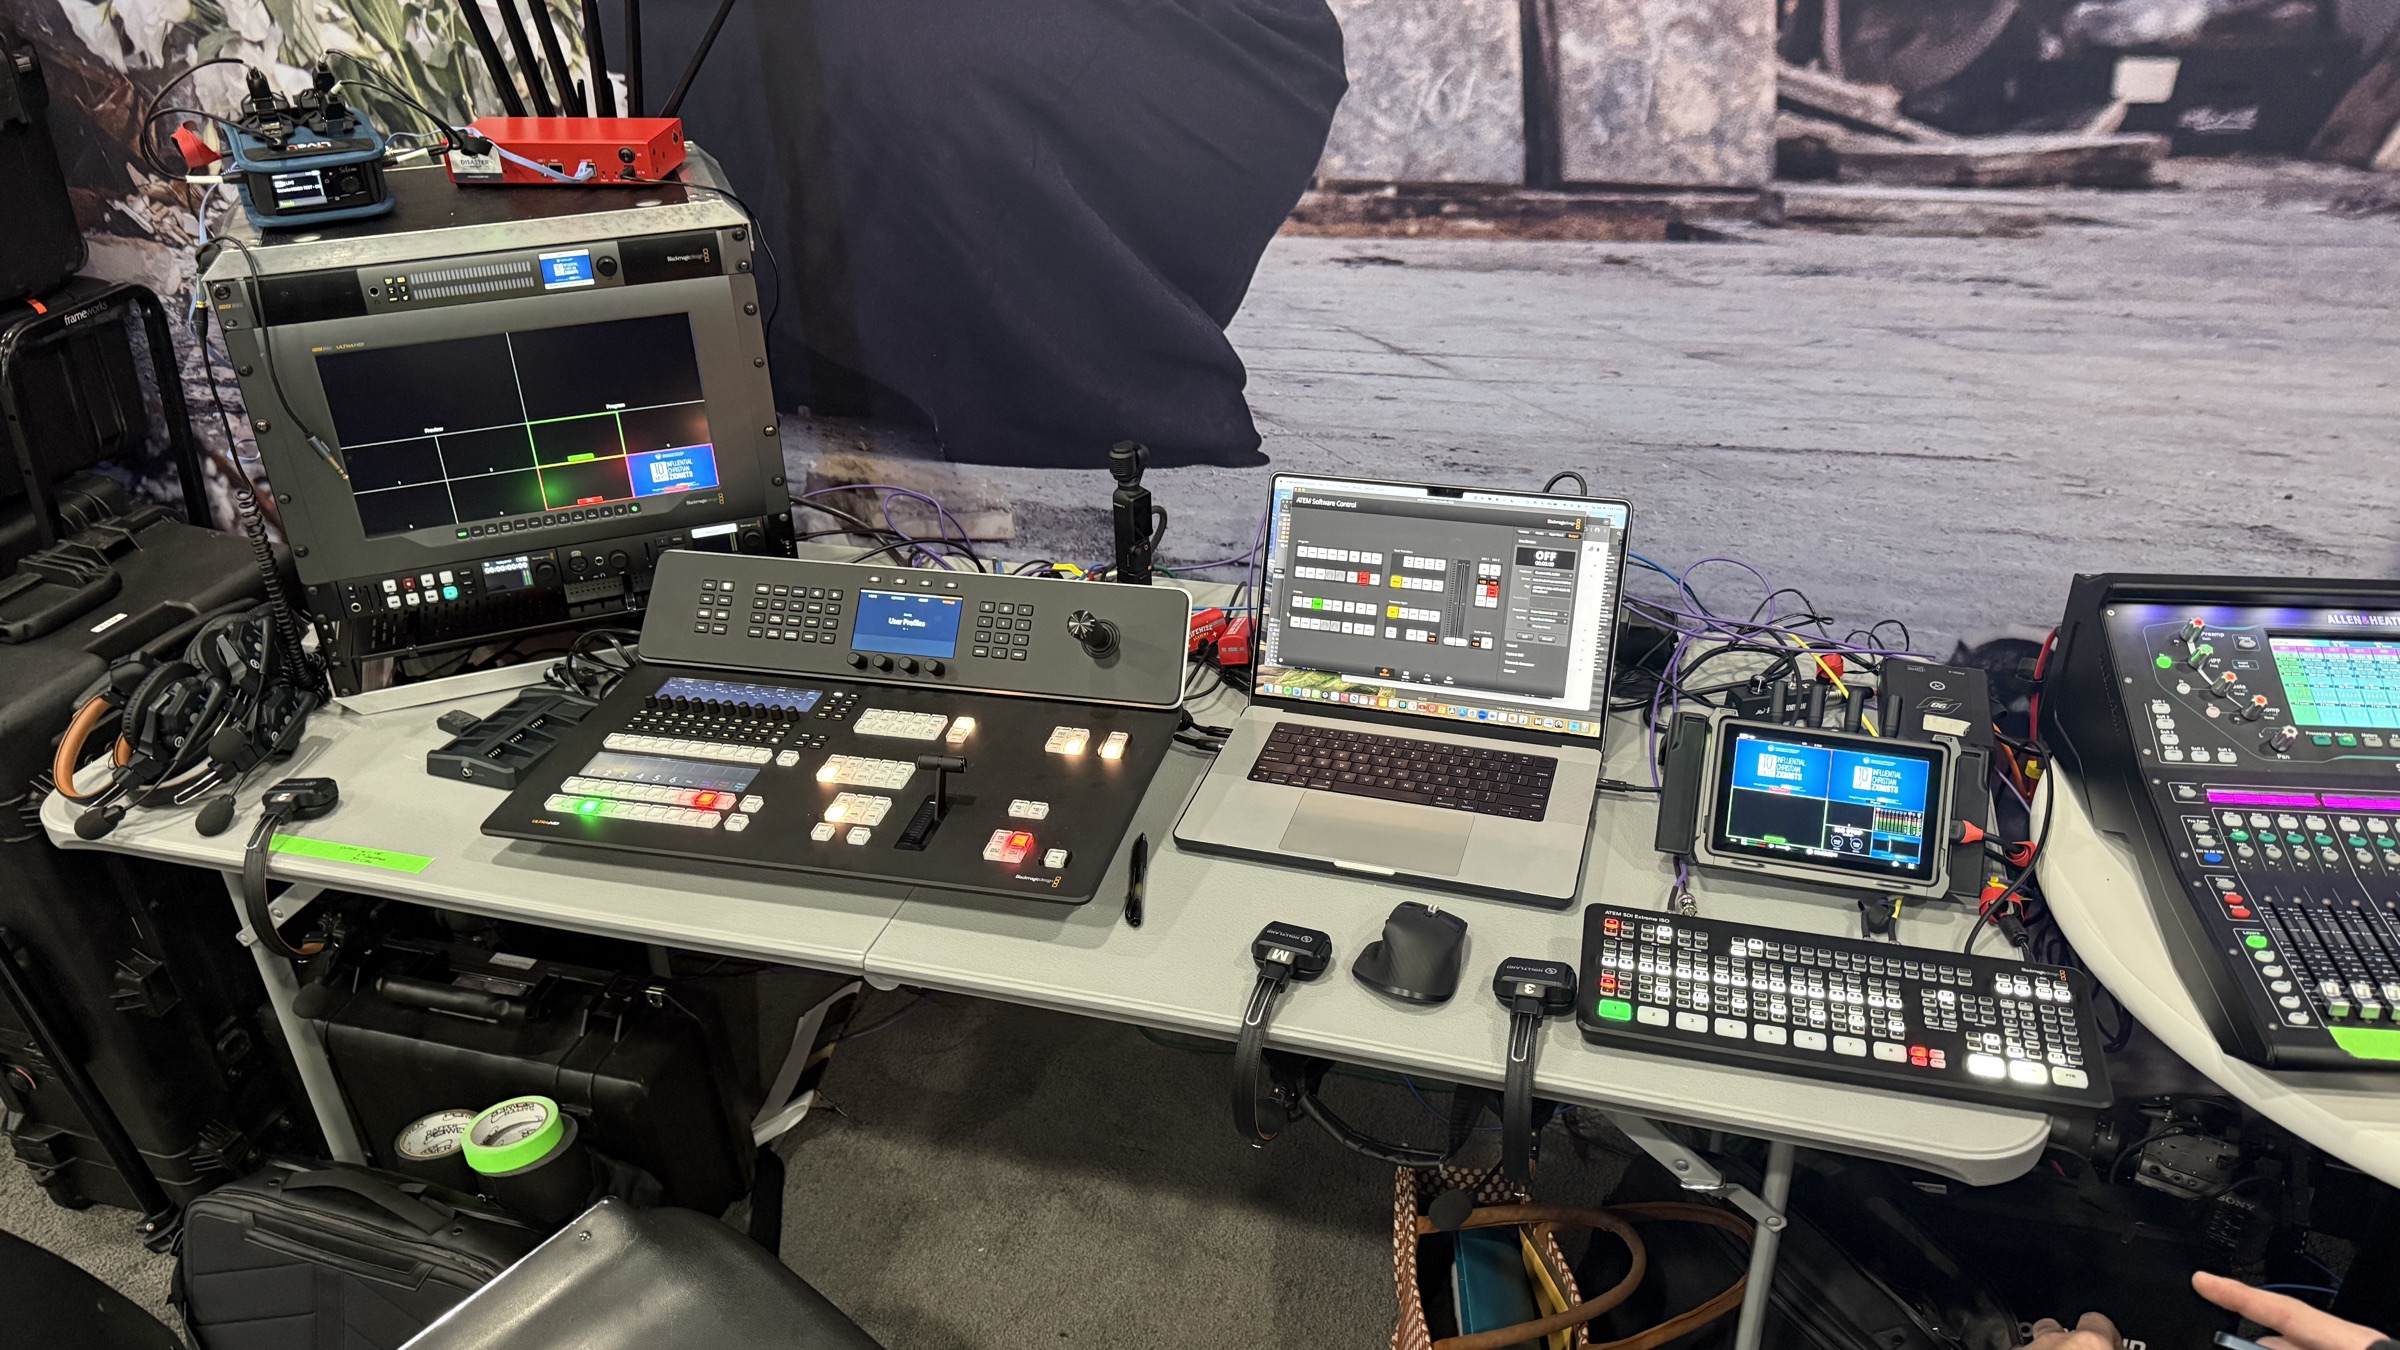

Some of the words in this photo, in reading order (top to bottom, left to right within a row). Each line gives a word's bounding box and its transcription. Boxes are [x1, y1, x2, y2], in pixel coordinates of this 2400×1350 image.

[64, 301, 108, 326] frameworks
[654, 463, 665, 476] 10
[1312, 498, 1335, 507] Software
[1336, 500, 1356, 509] Control
[1535, 551, 1557, 561] OFF
[2328, 615, 2400, 625] ALLEN&HEAT
[1763, 755, 1773, 769] 10
[1777, 756, 1806, 767] INFLUENTIAL
[1776, 764, 1801, 773] CHRISTIAN
[1873, 769, 1902, 779] INFLUENTIAL
[1859, 768, 1869, 782] 10
[1872, 776, 1897, 785] CHRISTIAN
[1634, 914, 1658, 922] Extreme
[1267, 929, 1300, 940] HOLLYLAND
[1272, 949, 1290, 962] M
[1524, 983, 1536, 994] 3
[425, 1128, 465, 1141] POWE
[2217, 1195, 2255, 1211] SONY
